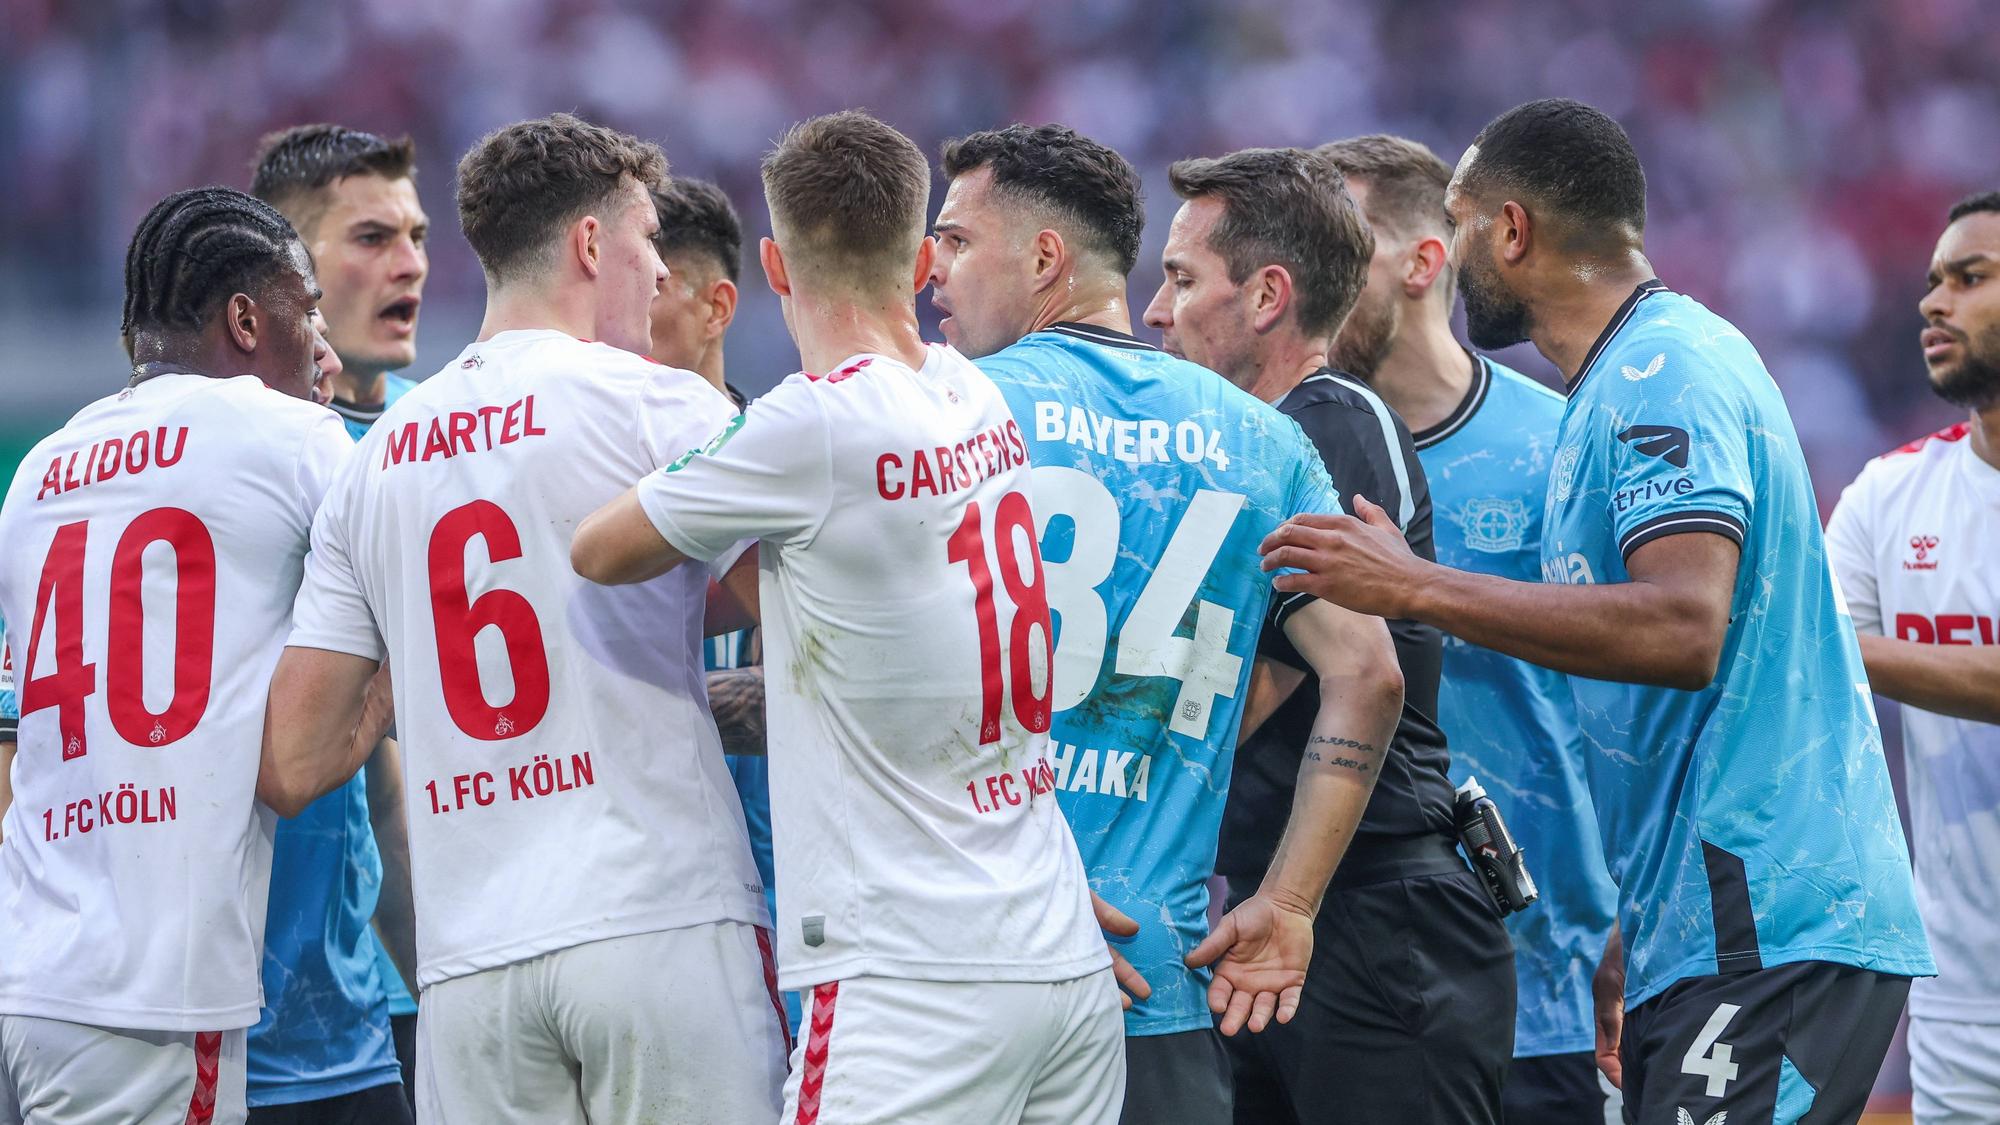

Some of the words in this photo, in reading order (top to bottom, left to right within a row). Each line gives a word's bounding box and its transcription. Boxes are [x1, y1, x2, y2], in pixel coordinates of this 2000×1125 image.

[37, 426, 189, 501] ALIDOU
[382, 394, 546, 471] MARTEL
[876, 419, 1030, 501] CARSTENS
[1613, 477, 1695, 512] trive
[20, 506, 216, 762] 40
[428, 499, 550, 741] 6
[947, 491, 1053, 746] 18
[1031, 465, 1248, 741] 34
[98, 783, 177, 828] KÖLN
[508, 751, 595, 801] KÖLN
[1680, 1002, 1743, 1098] 4
